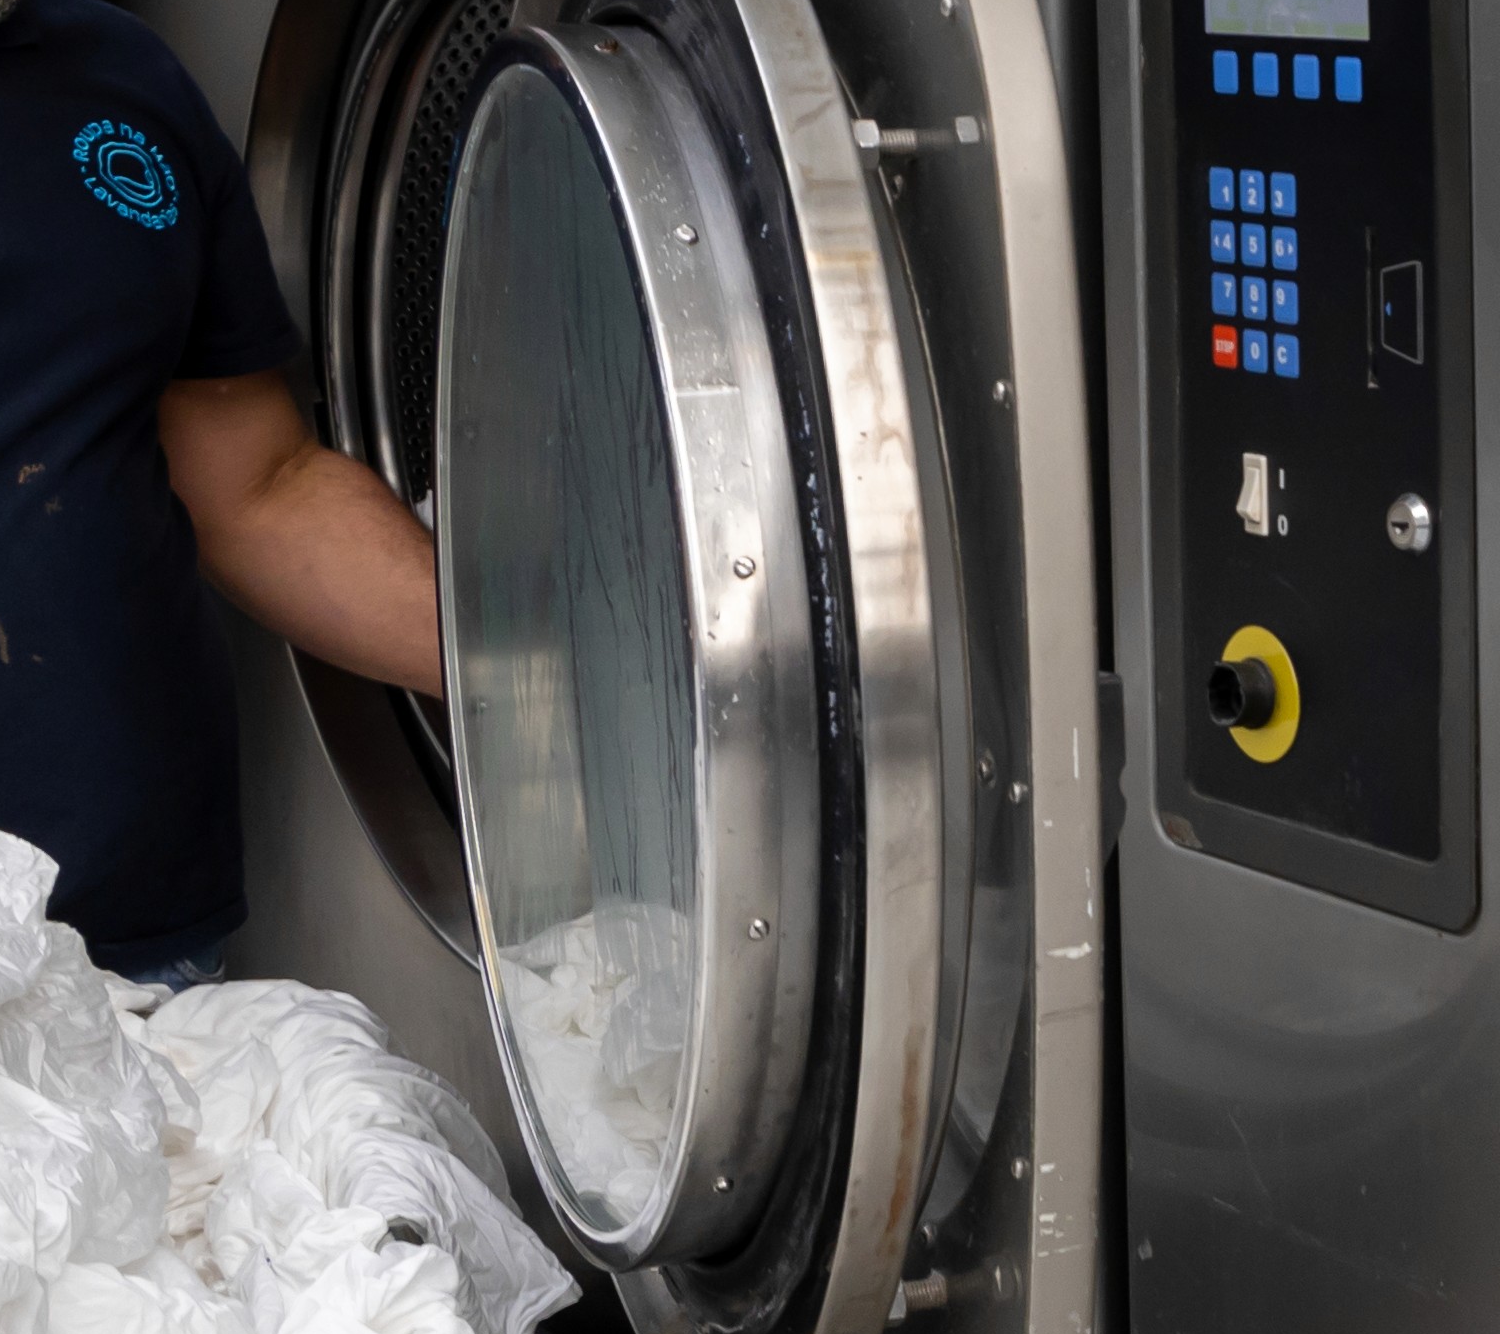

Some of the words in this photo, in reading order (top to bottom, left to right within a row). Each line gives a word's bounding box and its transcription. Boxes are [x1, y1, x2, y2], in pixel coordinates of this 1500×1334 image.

[72, 119, 114, 162] Roupa
[119, 122, 146, 145] na
[1222, 186, 1229, 202] 1
[1249, 188, 1256, 205] 2
[1275, 191, 1283, 208] 3
[1223, 234, 1231, 250] 4
[1250, 236, 1258, 253] 5
[1275, 239, 1284, 257] 6
[1224, 281, 1232, 298] 7
[1250, 284, 1259, 301] 8
[1276, 288, 1285, 305] 9
[1215, 340, 1234, 353] STOP
[1251, 342, 1260, 359] 0
[1277, 347, 1287, 364] C
[1278, 514, 1288, 536] 0
